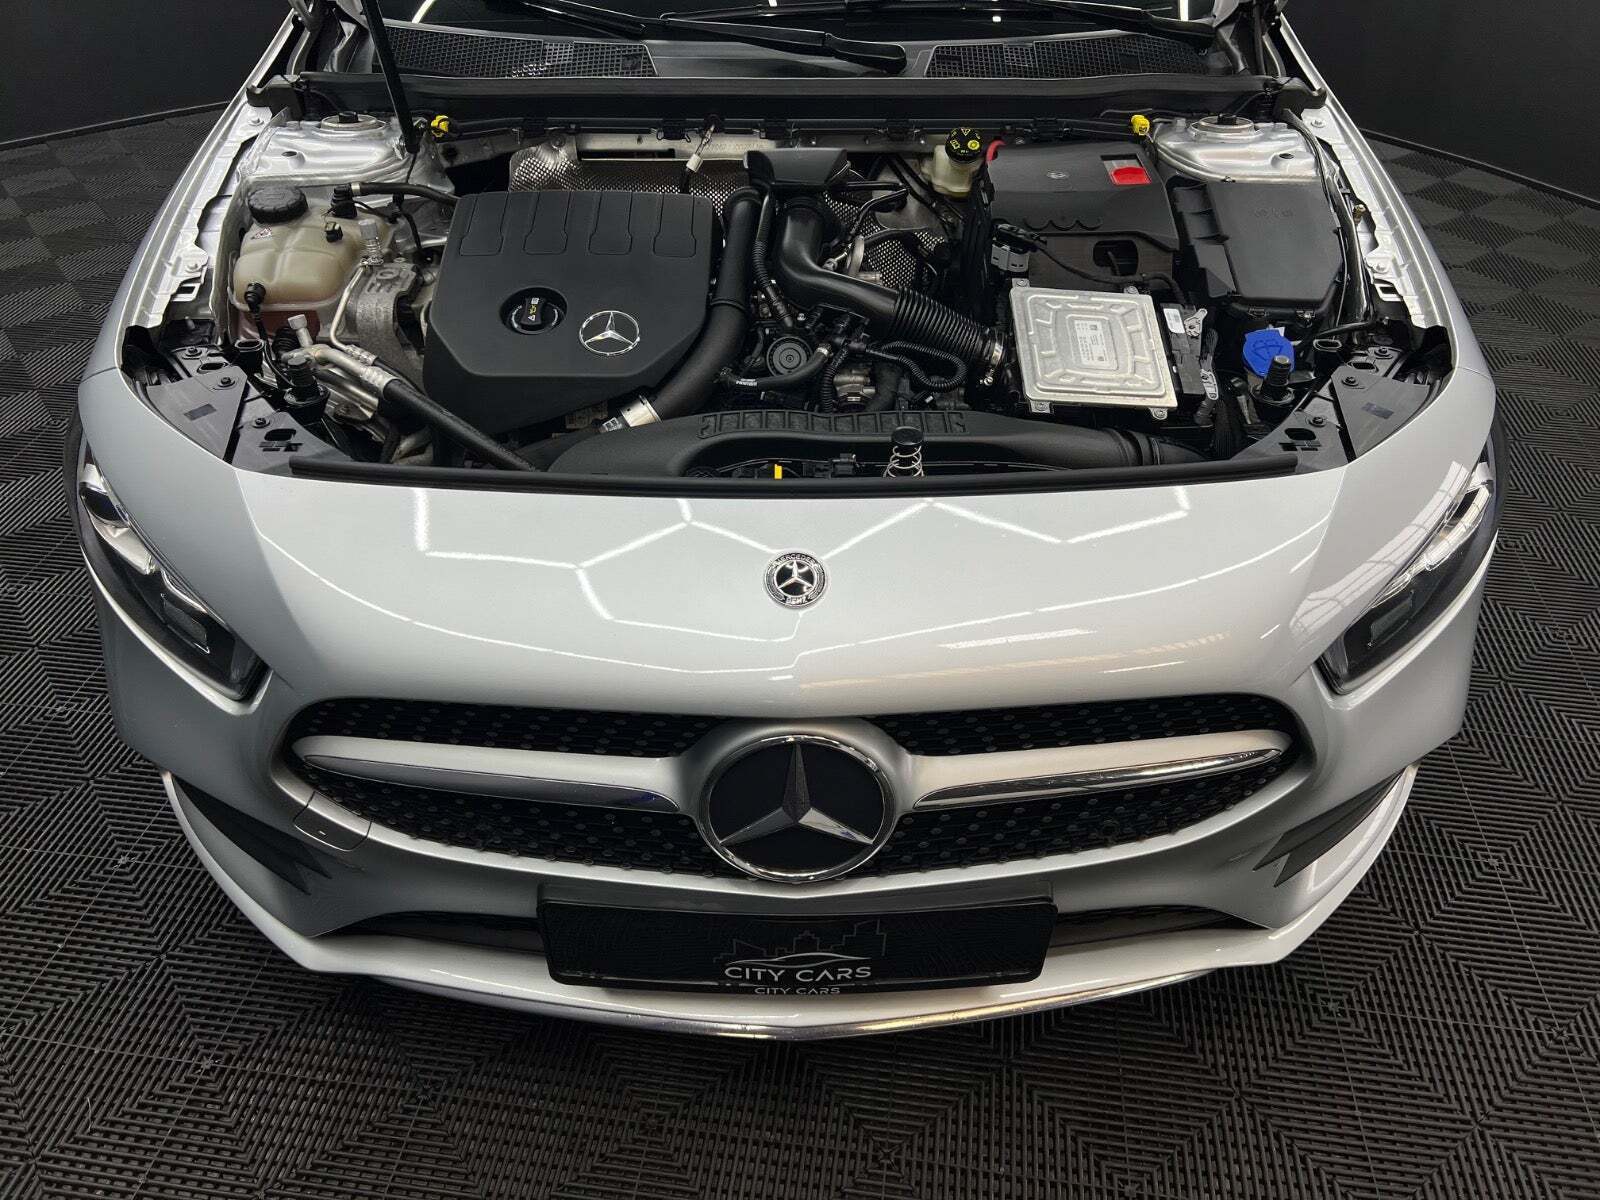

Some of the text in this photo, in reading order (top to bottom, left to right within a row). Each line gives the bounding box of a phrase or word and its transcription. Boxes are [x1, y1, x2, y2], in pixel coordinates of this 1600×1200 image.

[724, 966, 871, 982] CITY CARS
[754, 987, 841, 995] CITY CARS
